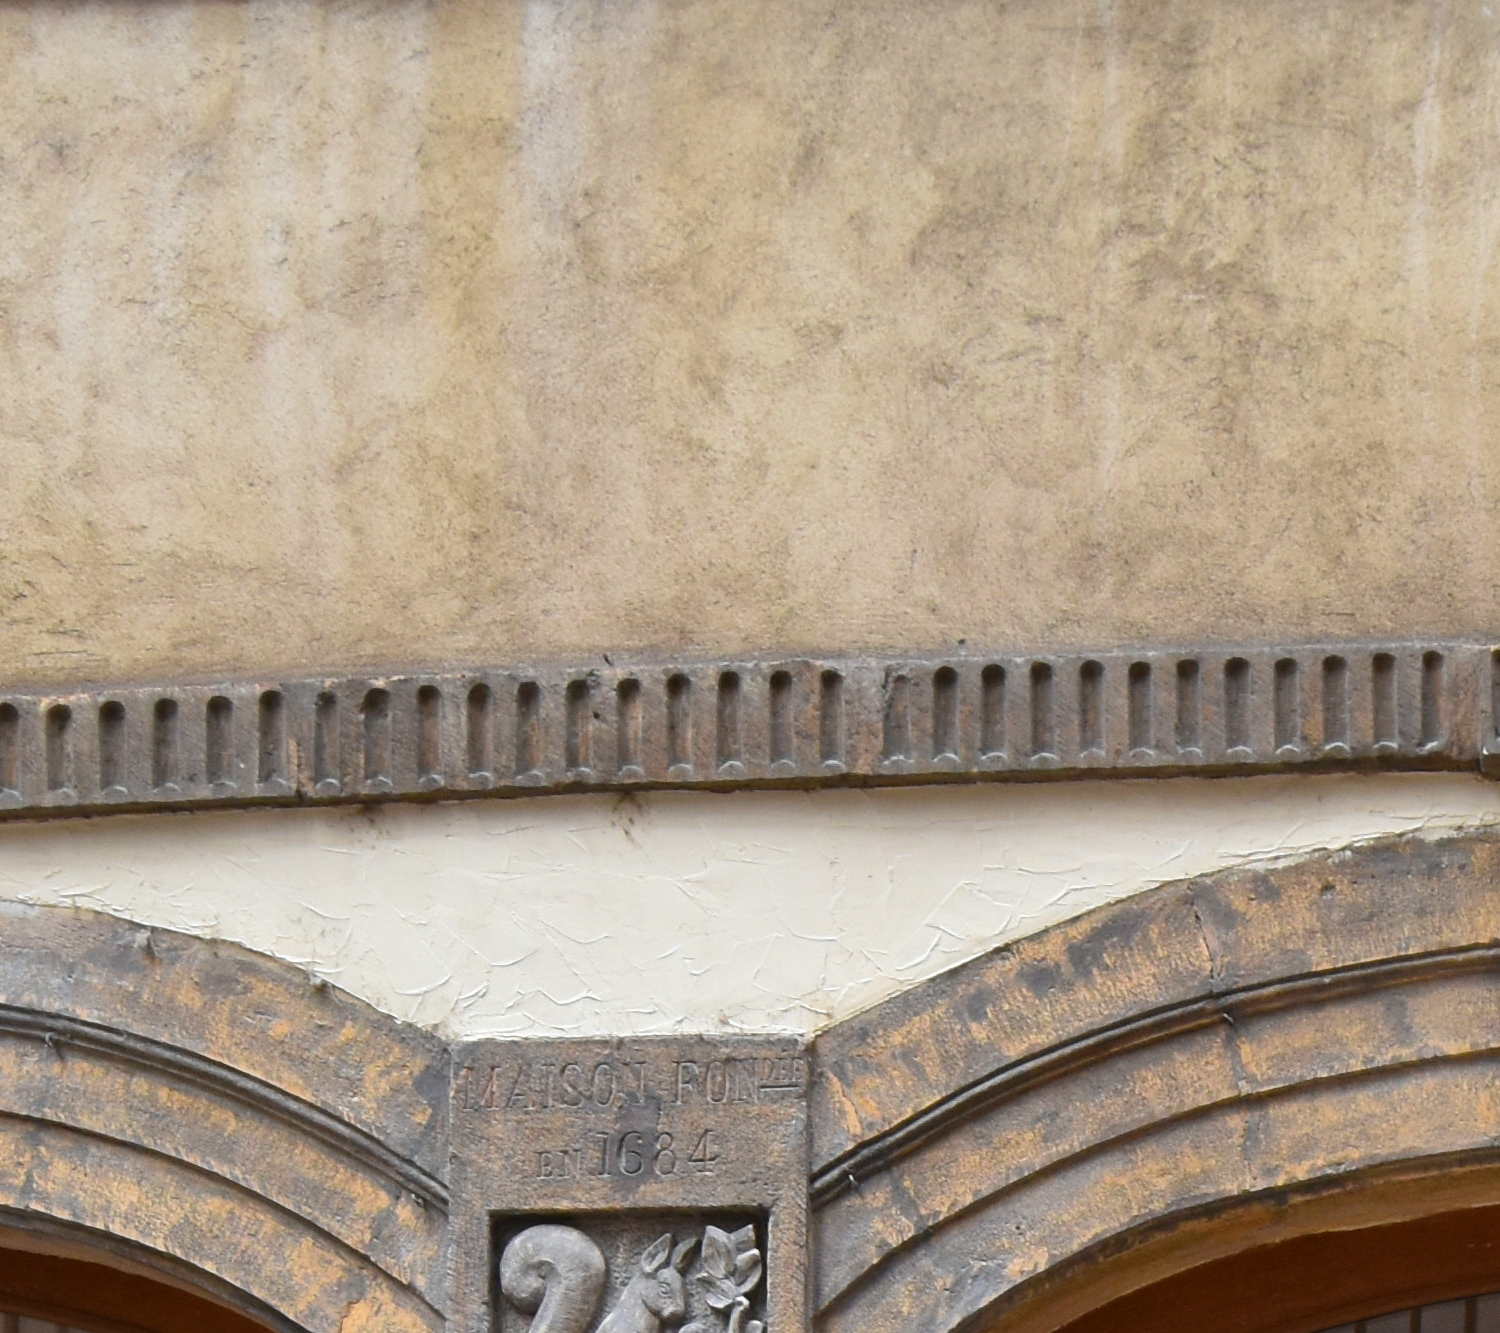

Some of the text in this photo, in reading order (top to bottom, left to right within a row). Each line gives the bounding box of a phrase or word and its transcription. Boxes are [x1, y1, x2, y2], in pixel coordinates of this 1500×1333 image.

[462, 1060, 647, 1111] MAISON
[536, 1128, 720, 1180] EN 1684
